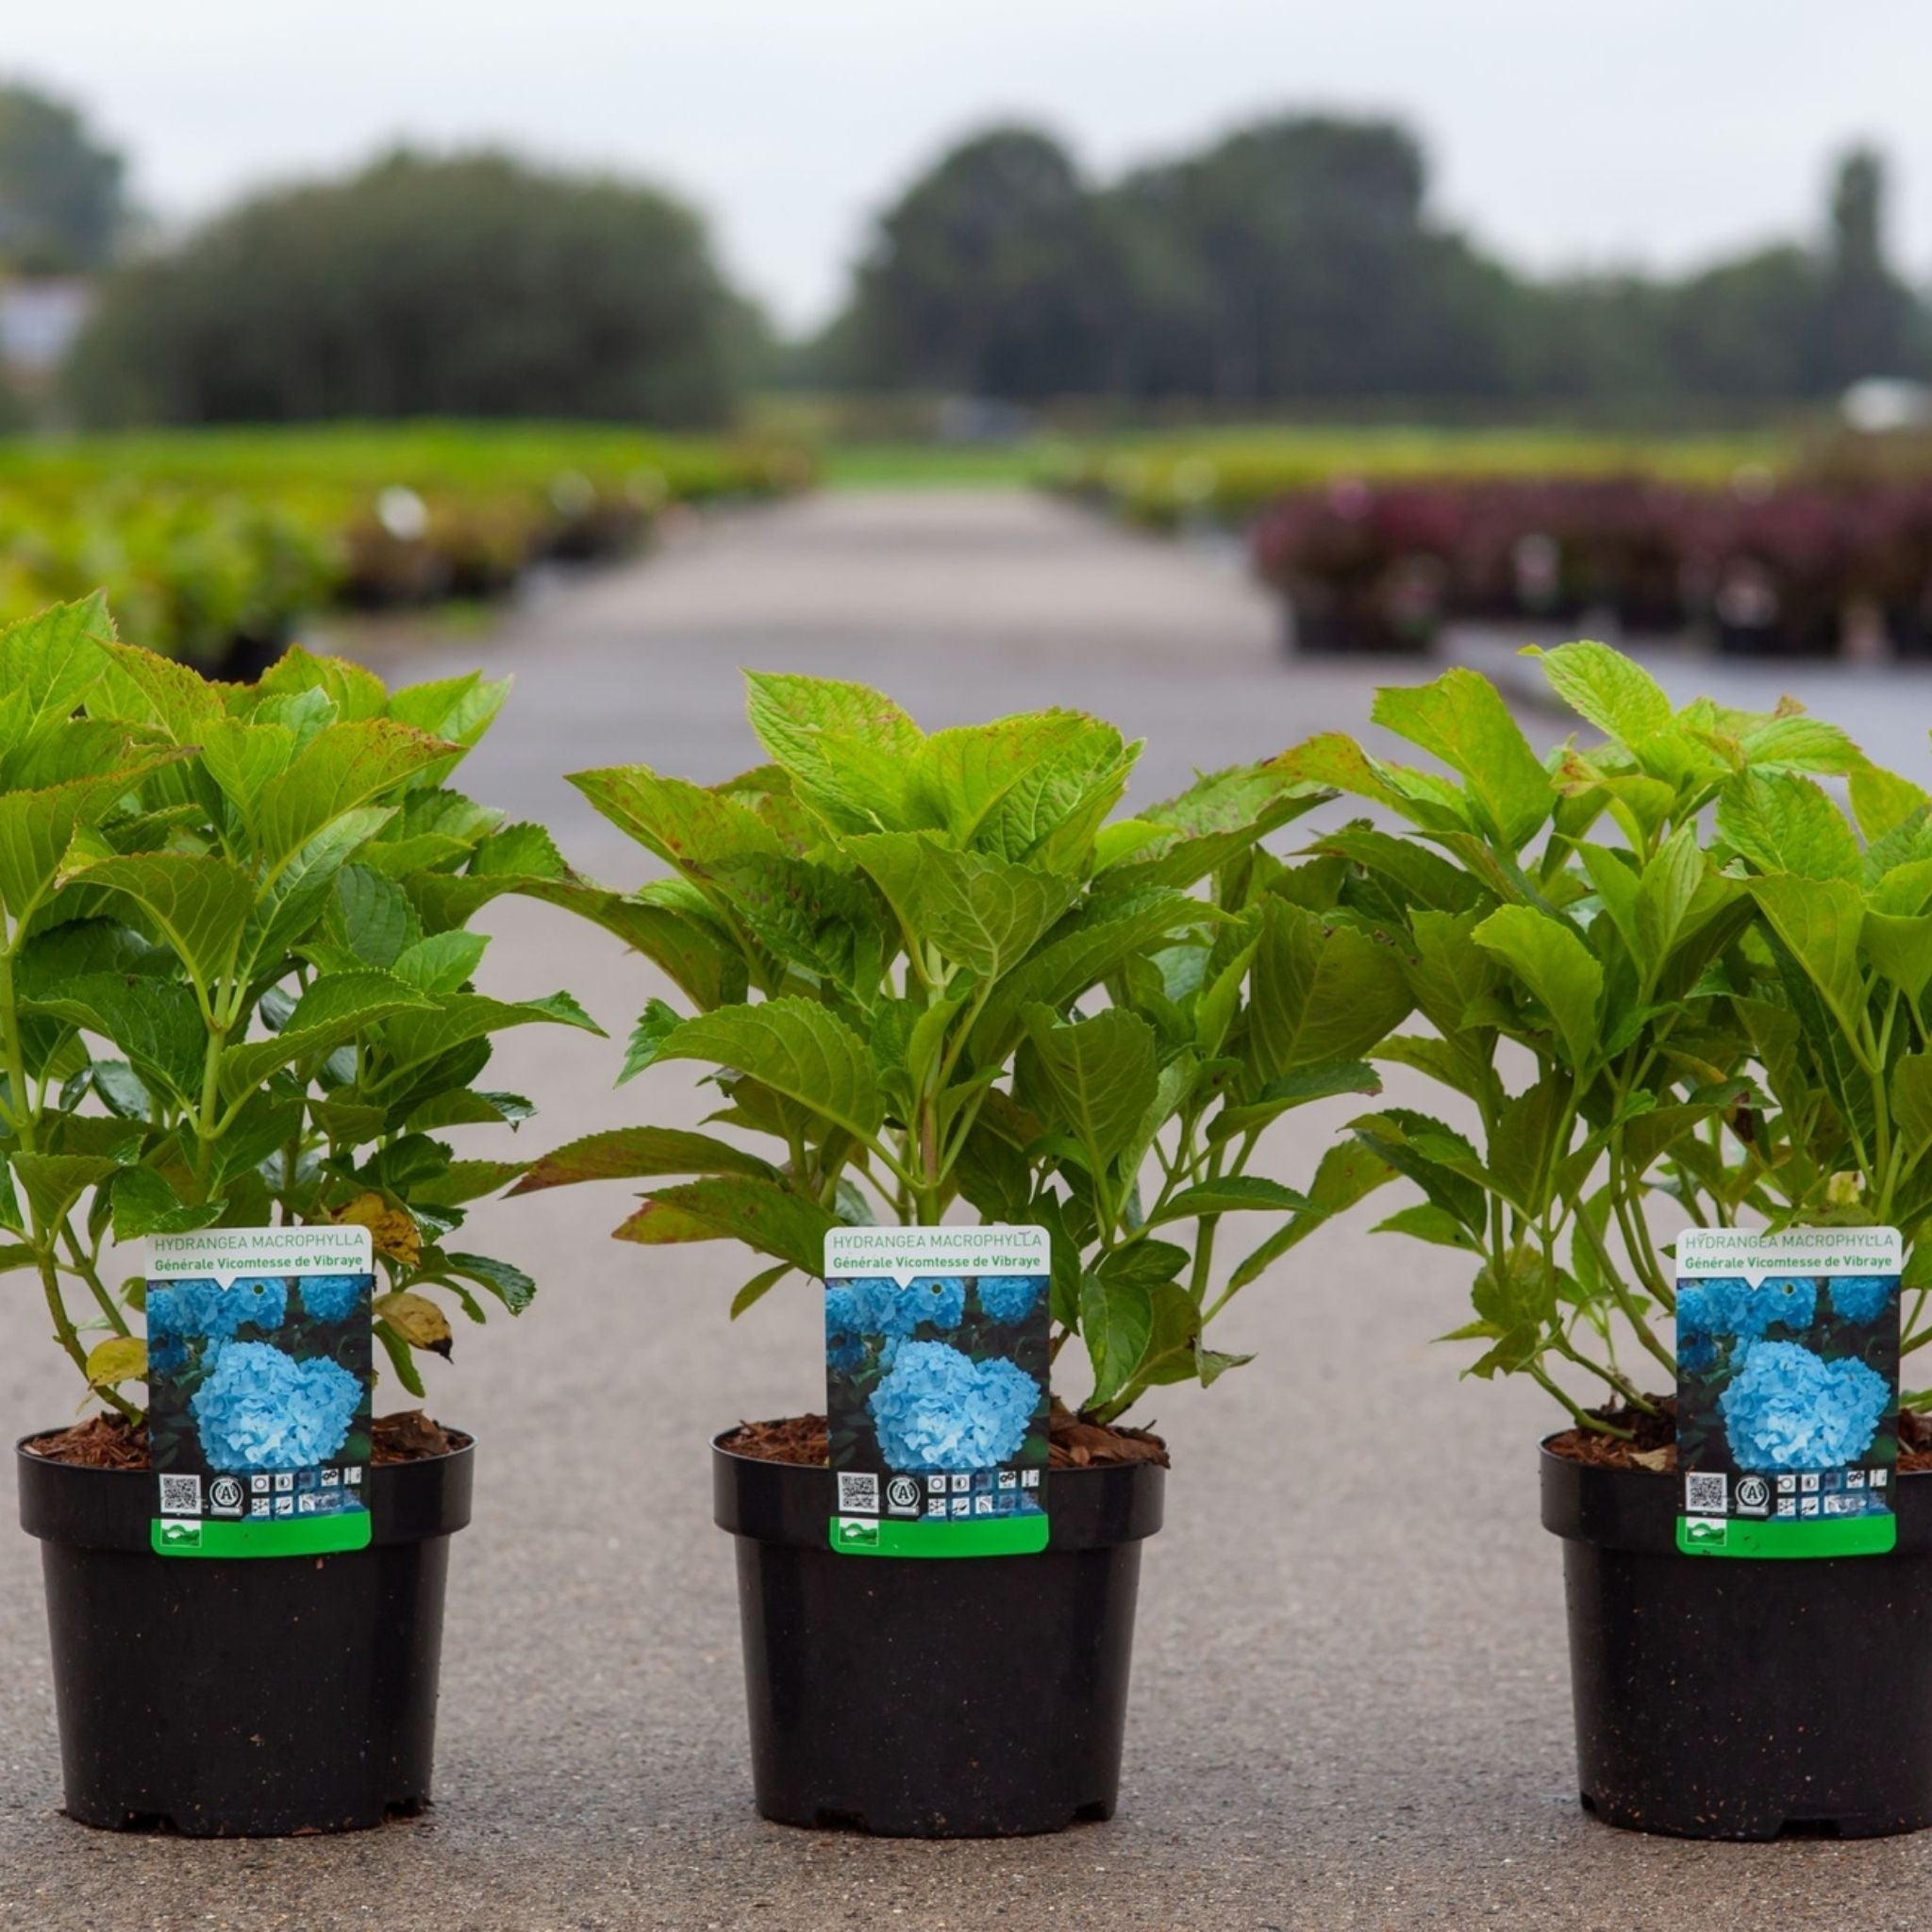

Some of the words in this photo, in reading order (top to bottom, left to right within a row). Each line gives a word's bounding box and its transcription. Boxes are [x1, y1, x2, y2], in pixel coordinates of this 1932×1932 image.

[155, 1237, 247, 1251] HYDRANGEA
[253, 1234, 364, 1248] MACROPHYLLA
[833, 1236, 925, 1248] HYDRANGEA
[931, 1234, 1041, 1247] MACROPHYLLA
[1686, 1236, 1777, 1249] HYDRANGEA
[1783, 1235, 1893, 1247] MACROPHYLLA
[156, 1258, 213, 1271] Générale
[217, 1257, 291, 1269] Vicomtesse
[295, 1256, 309, 1267] de
[313, 1255, 362, 1268] Vibraye
[833, 1257, 892, 1268] Générale
[896, 1257, 969, 1268] Vicomtesse
[974, 1256, 988, 1267] de
[991, 1256, 1041, 1268] Vibraye
[1685, 1257, 1744, 1269] Générale
[1748, 1257, 1821, 1268] Vicomtesse
[1825, 1257, 1840, 1267] de
[1843, 1256, 1892, 1268] Vibraye
